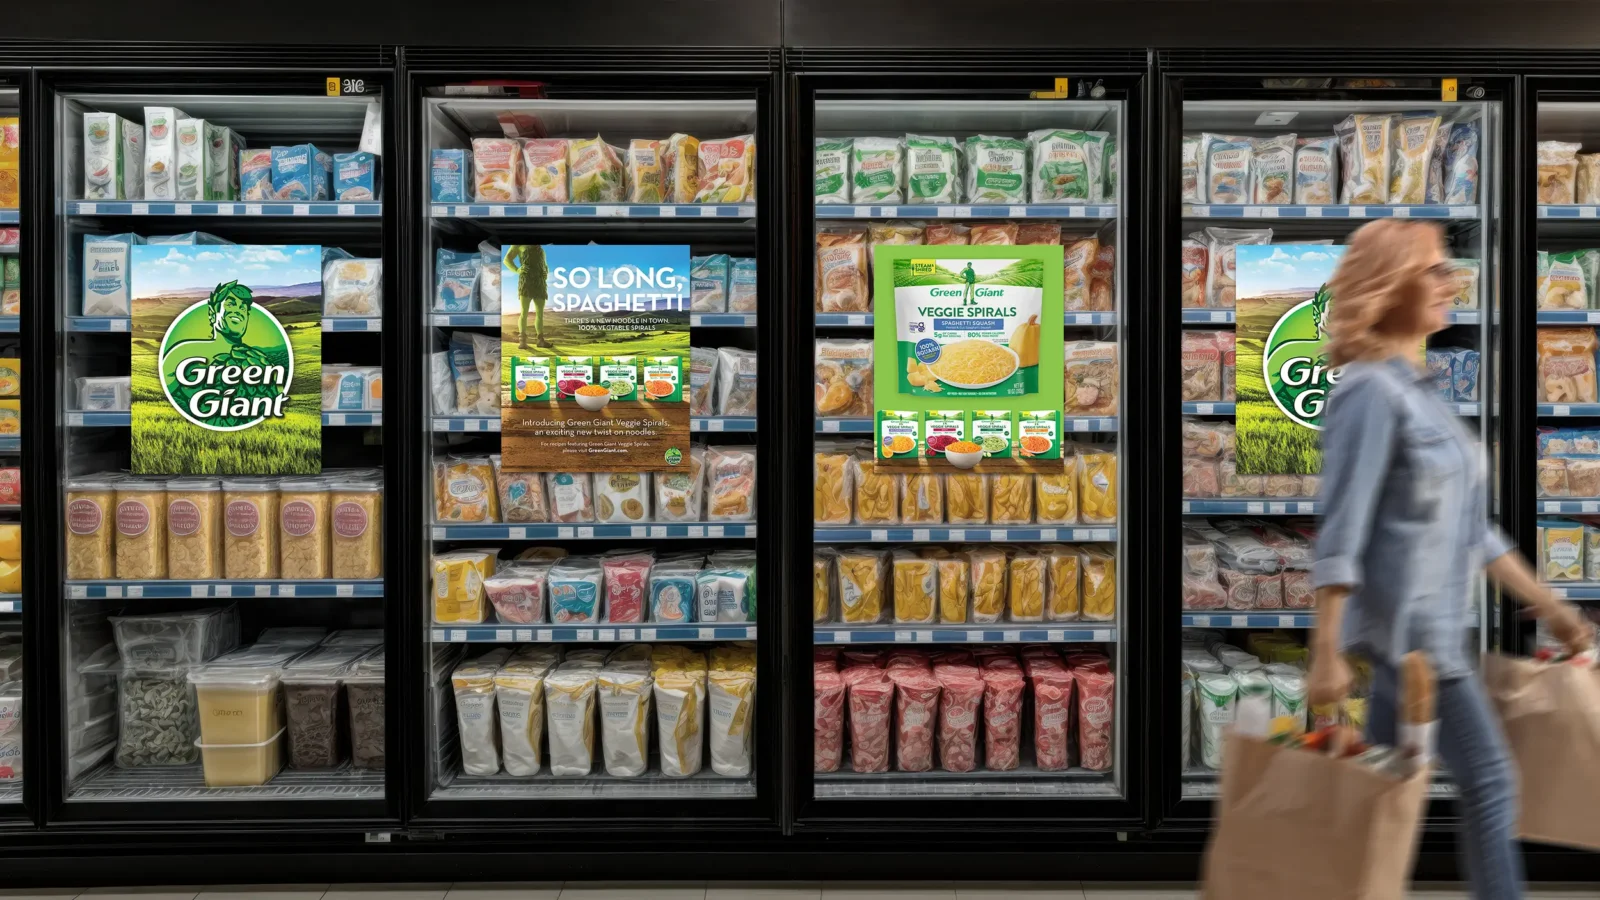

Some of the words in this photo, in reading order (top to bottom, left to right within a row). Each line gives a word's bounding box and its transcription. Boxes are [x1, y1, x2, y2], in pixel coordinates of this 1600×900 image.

[553, 267, 591, 289] SO
[598, 267, 683, 291] LONG,
[930, 287, 962, 297] Green
[975, 287, 1004, 297] Giant
[552, 293, 683, 312] SPAGHETTI
[918, 307, 964, 317] VEGGIE
[967, 307, 1017, 317] SPIRALS
[916, 346, 940, 356] SQUASH
[920, 342, 934, 350] 100%
[175, 357, 285, 386] Green
[1280, 356, 1345, 386] Gre
[189, 389, 289, 418] Giant
[522, 418, 565, 428] Introducing
[567, 418, 591, 426] Green
[593, 418, 614, 426] Giant
[616, 419, 641, 428] Veggie
[545, 429, 575, 438] exciting
[625, 428, 657, 436] noodles.
